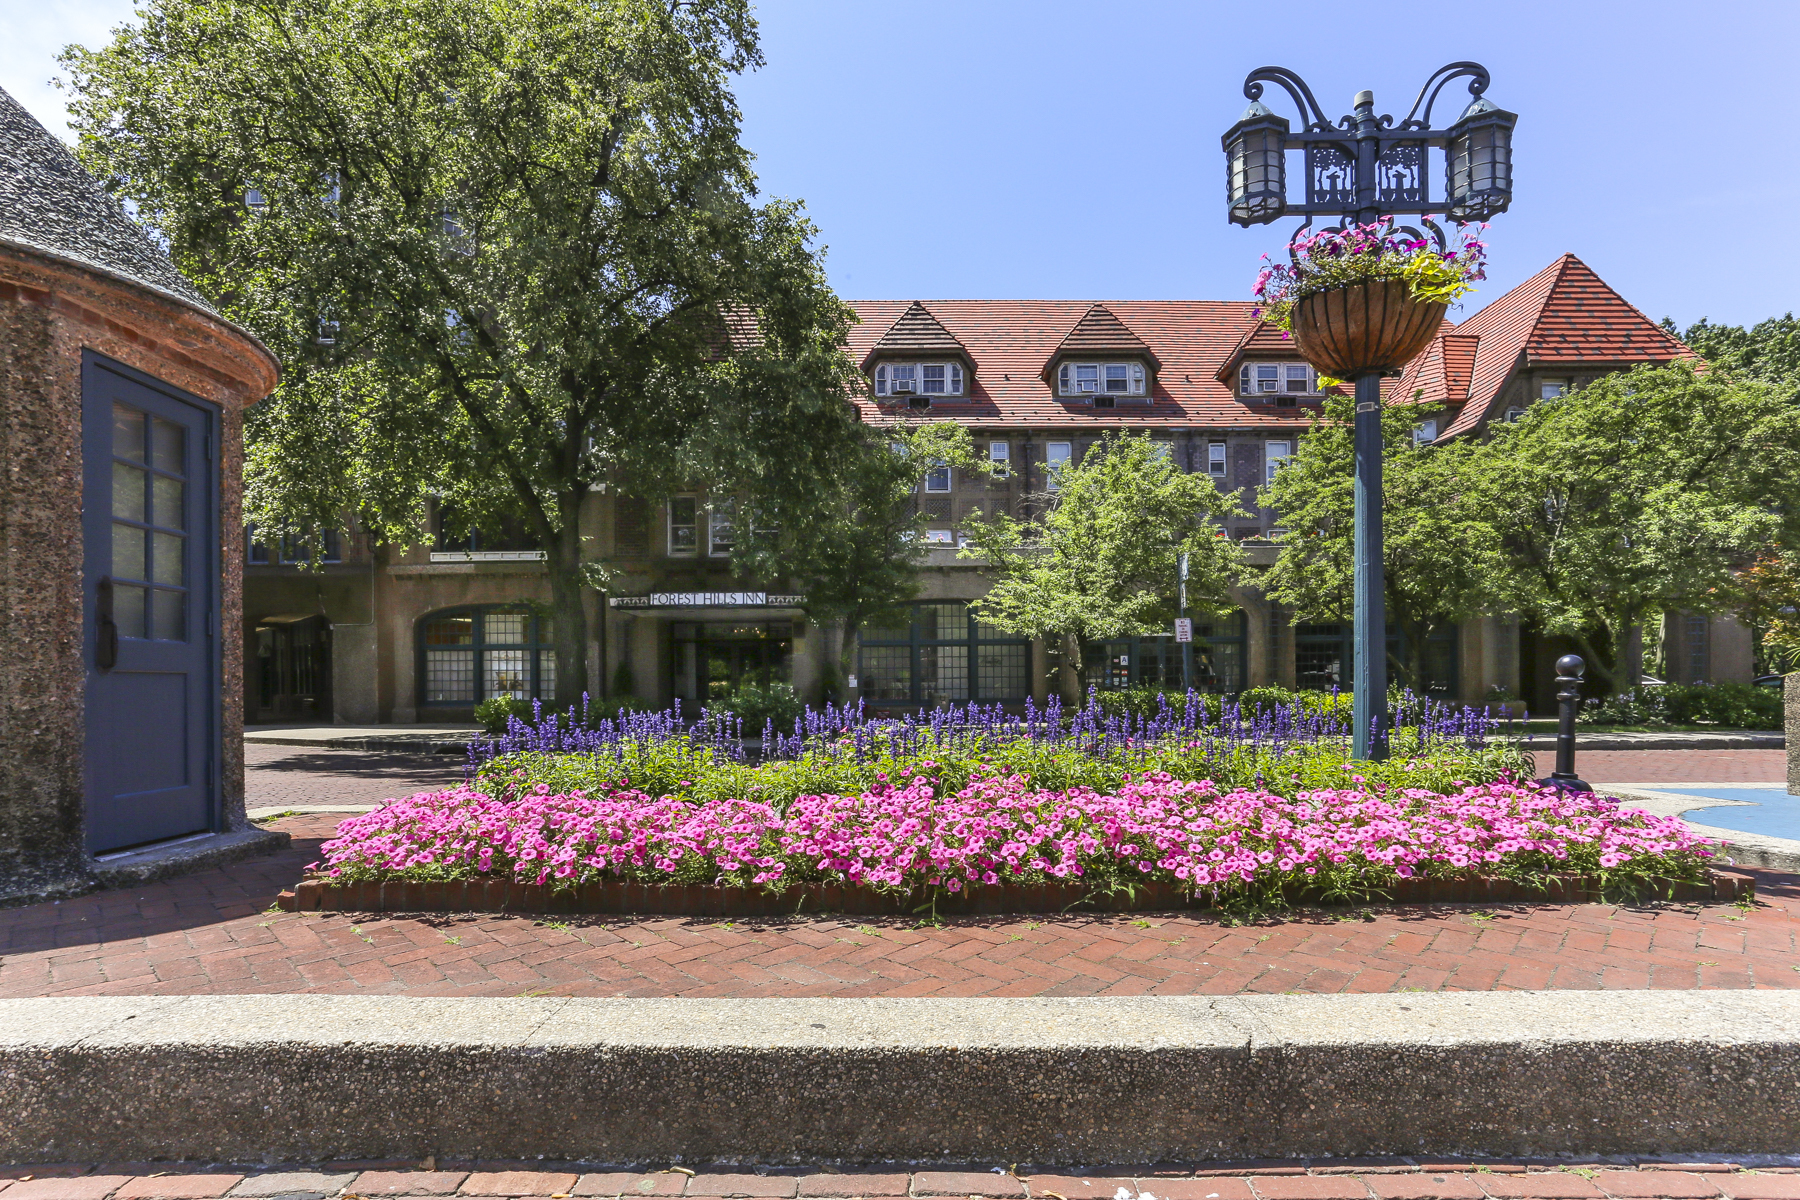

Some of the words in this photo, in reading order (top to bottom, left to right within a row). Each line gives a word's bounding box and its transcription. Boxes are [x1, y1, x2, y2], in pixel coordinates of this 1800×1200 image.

[652, 593, 699, 605] FOREST
[703, 593, 737, 605] HILLS
[742, 593, 764, 605] INN
